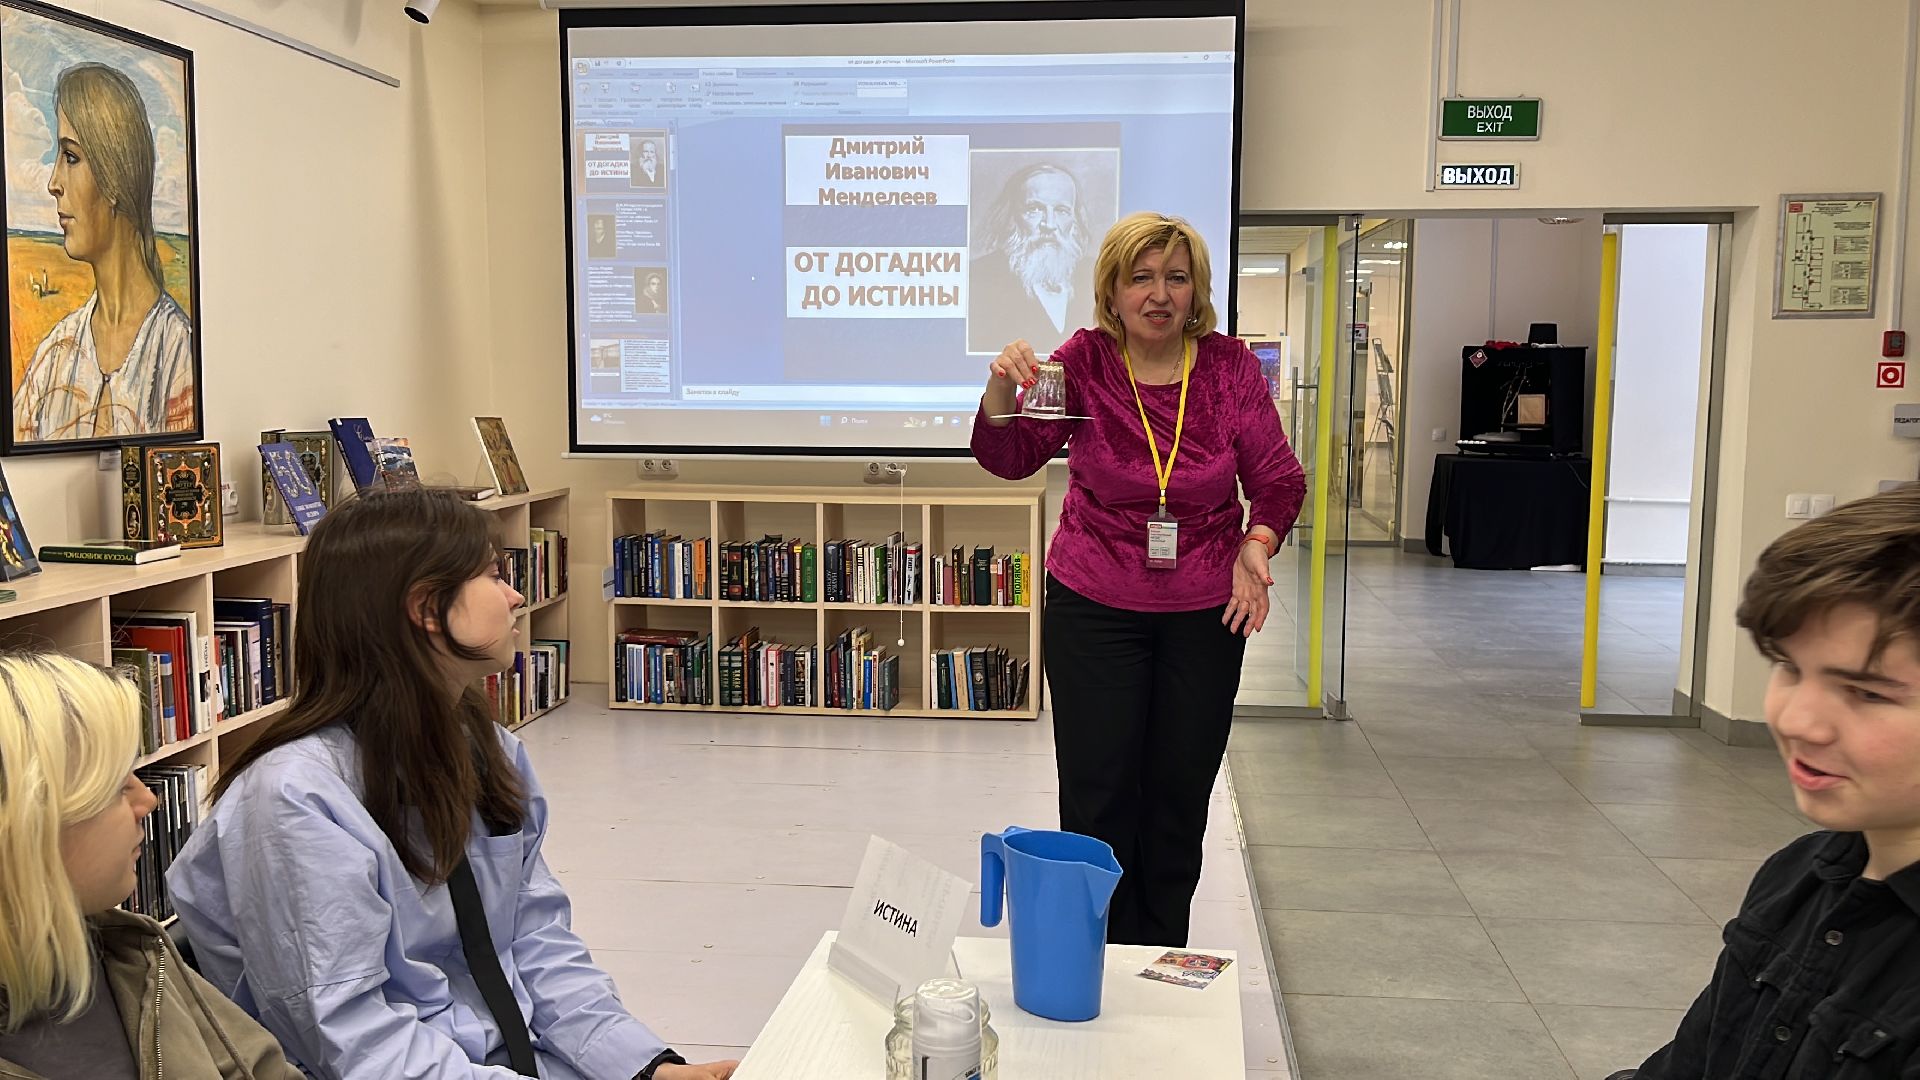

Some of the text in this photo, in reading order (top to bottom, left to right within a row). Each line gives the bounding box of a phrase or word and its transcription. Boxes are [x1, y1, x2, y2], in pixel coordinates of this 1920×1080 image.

[1467, 105, 1513, 121] ВЫХОД
[1476, 122, 1504, 132] EXIT
[829, 136, 925, 158] Дмитрий
[825, 163, 929, 180] Иванович
[1442, 167, 1511, 184] ВЫХОД
[818, 187, 938, 208] Менделеев
[794, 252, 961, 277] ОТ ДОГАДКИ
[801, 285, 960, 310] ДО ИСТИНЫ
[63, 551, 103, 560] ЖИВОПИСЬ
[103, 554, 133, 562] РУССКАЯ
[873, 899, 918, 938] ИСТИНА
